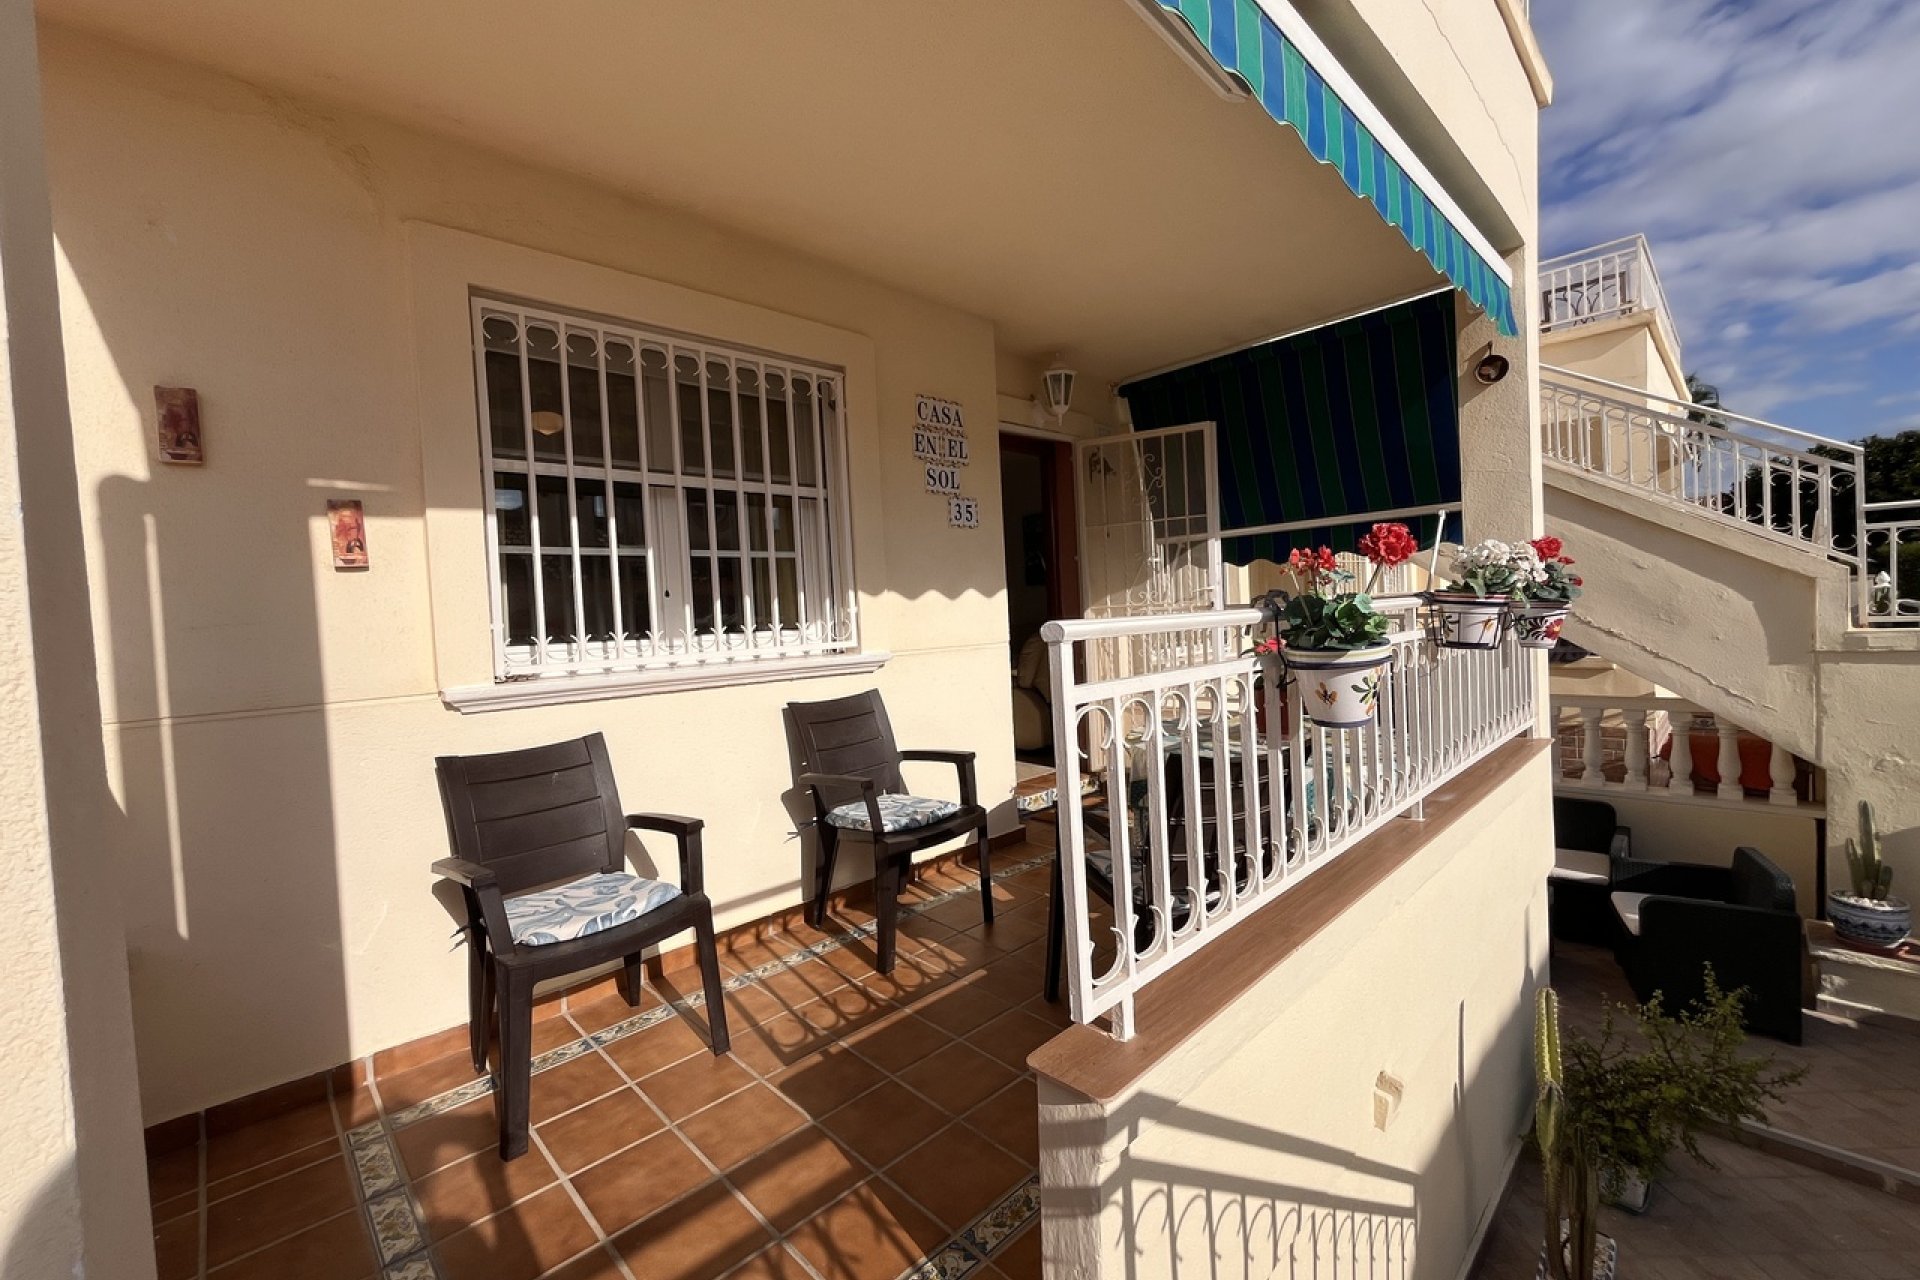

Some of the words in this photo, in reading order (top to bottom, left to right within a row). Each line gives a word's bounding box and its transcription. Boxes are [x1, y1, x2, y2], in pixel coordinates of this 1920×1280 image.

[917, 400, 964, 428] CASA
[914, 432, 937, 455] EN
[948, 438, 968, 459] EL
[926, 467, 960, 490] SOL
[954, 502, 973, 522] 35
